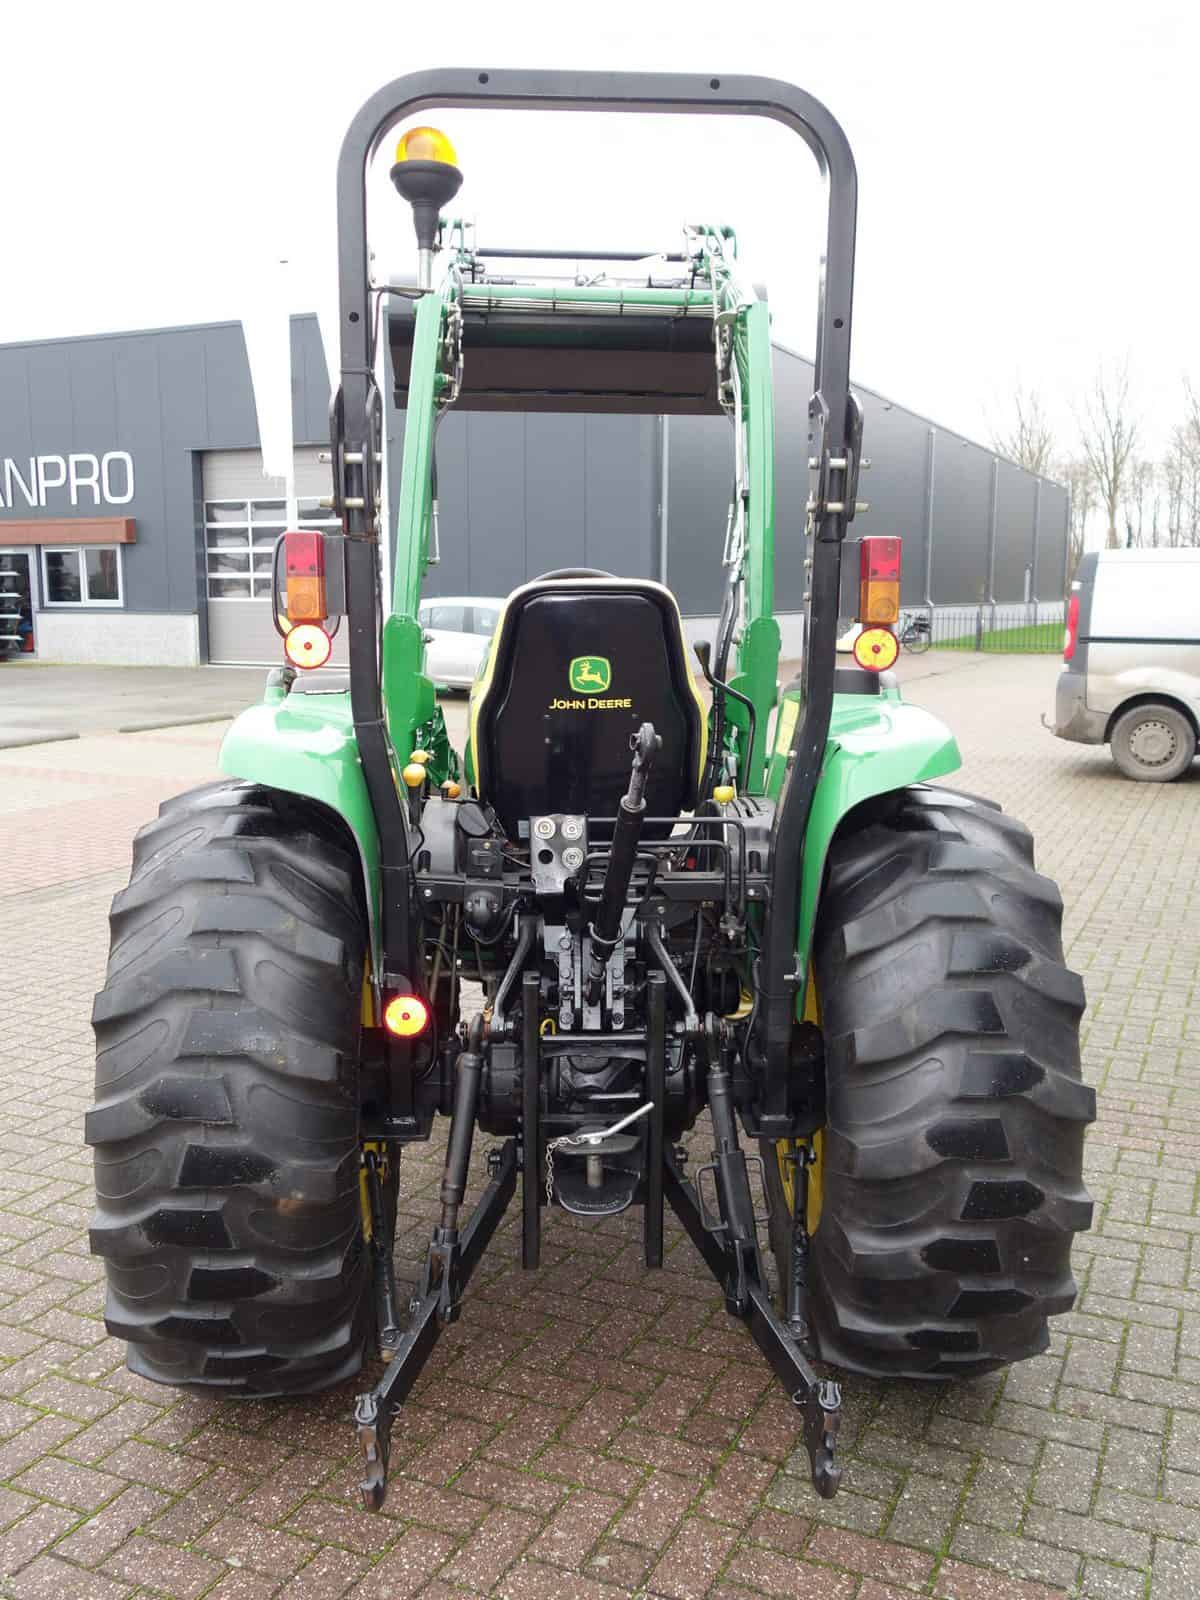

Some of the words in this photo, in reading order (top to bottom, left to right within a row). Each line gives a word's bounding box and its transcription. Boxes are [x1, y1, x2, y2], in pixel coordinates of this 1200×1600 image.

[0, 451, 134, 507] NPRO
[549, 698, 585, 709] JOHN
[588, 698, 632, 709] DEERE
